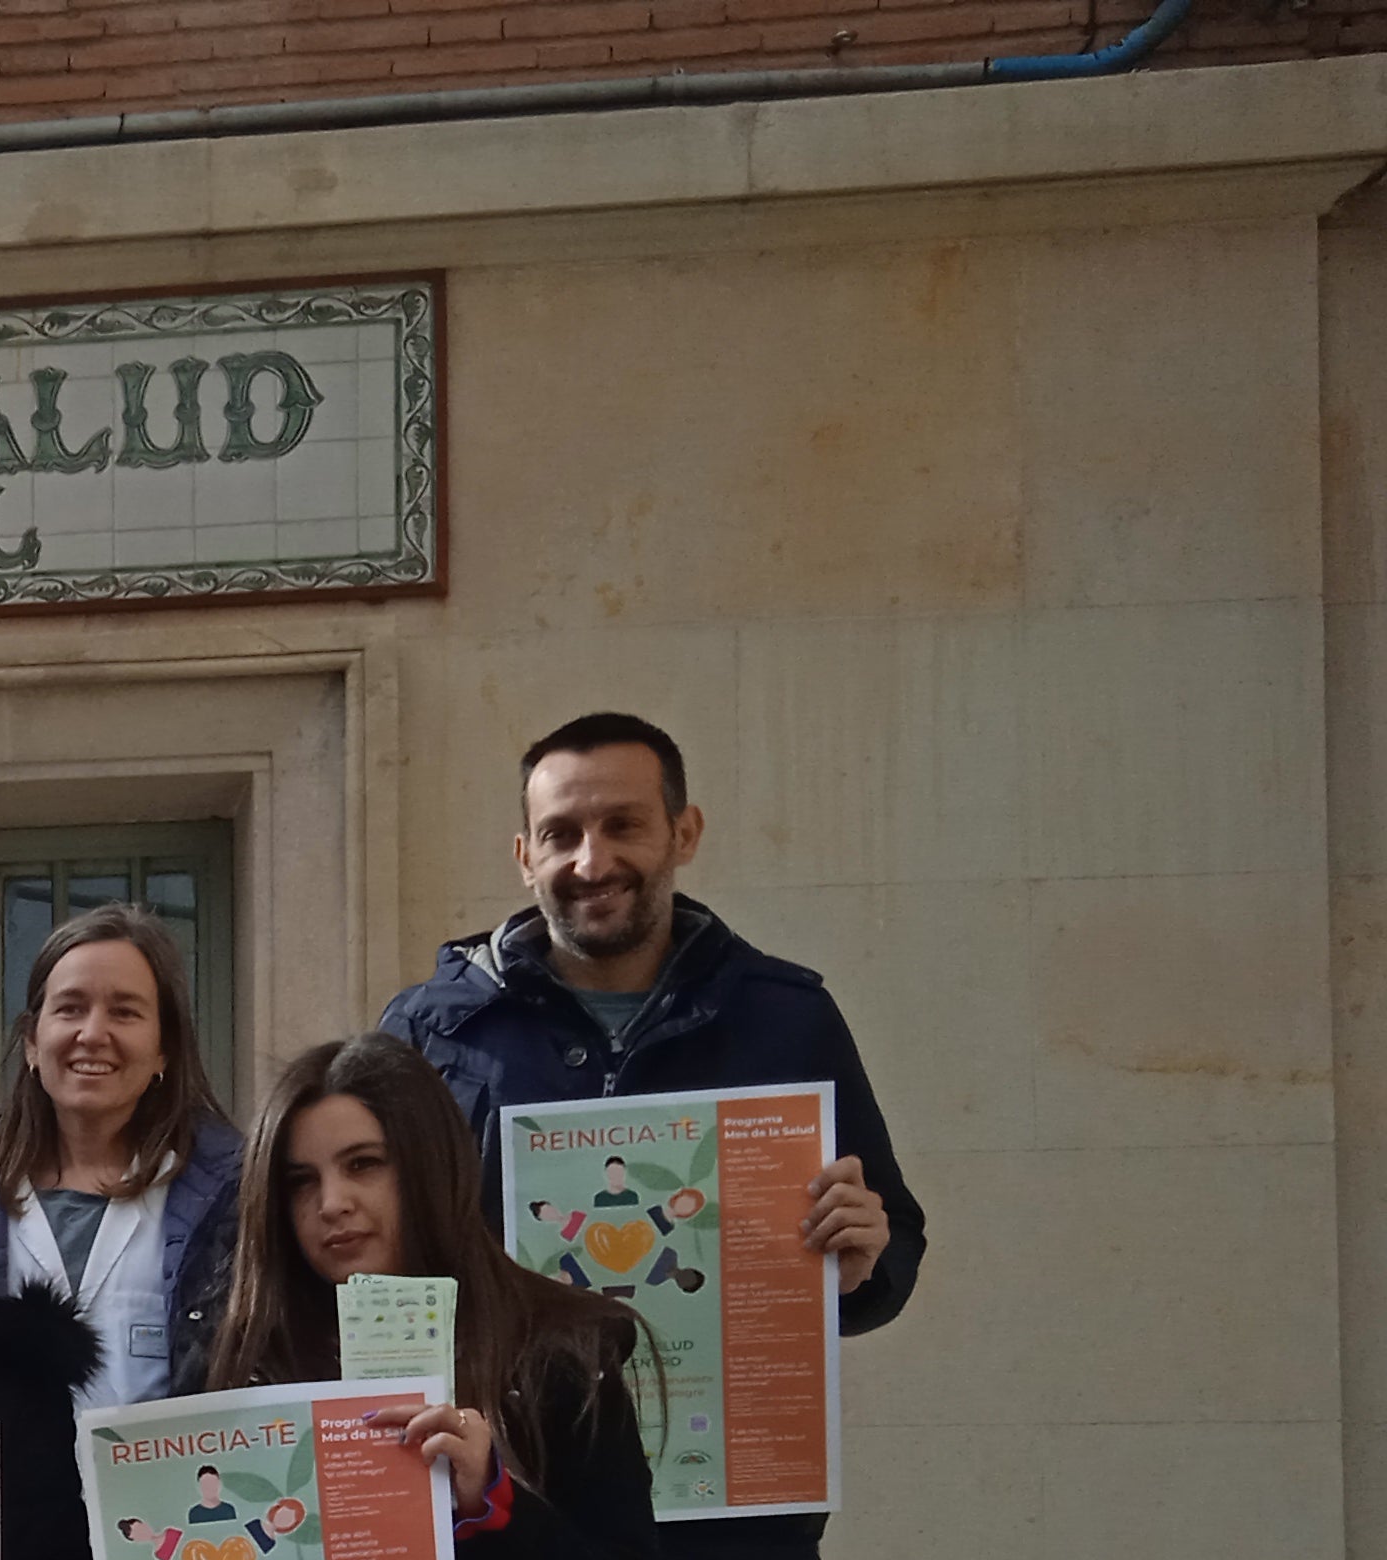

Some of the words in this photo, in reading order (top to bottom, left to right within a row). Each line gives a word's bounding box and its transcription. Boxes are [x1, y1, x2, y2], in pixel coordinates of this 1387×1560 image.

[529, 1120, 700, 1152] REINICIA-TE
[321, 1418, 364, 1429] Progra
[321, 1430, 347, 1443] Mes
[350, 1428, 366, 1440] de
[369, 1427, 381, 1438] la
[384, 1427, 404, 1437] Sal
[111, 1421, 297, 1465] REINICIA-TE
